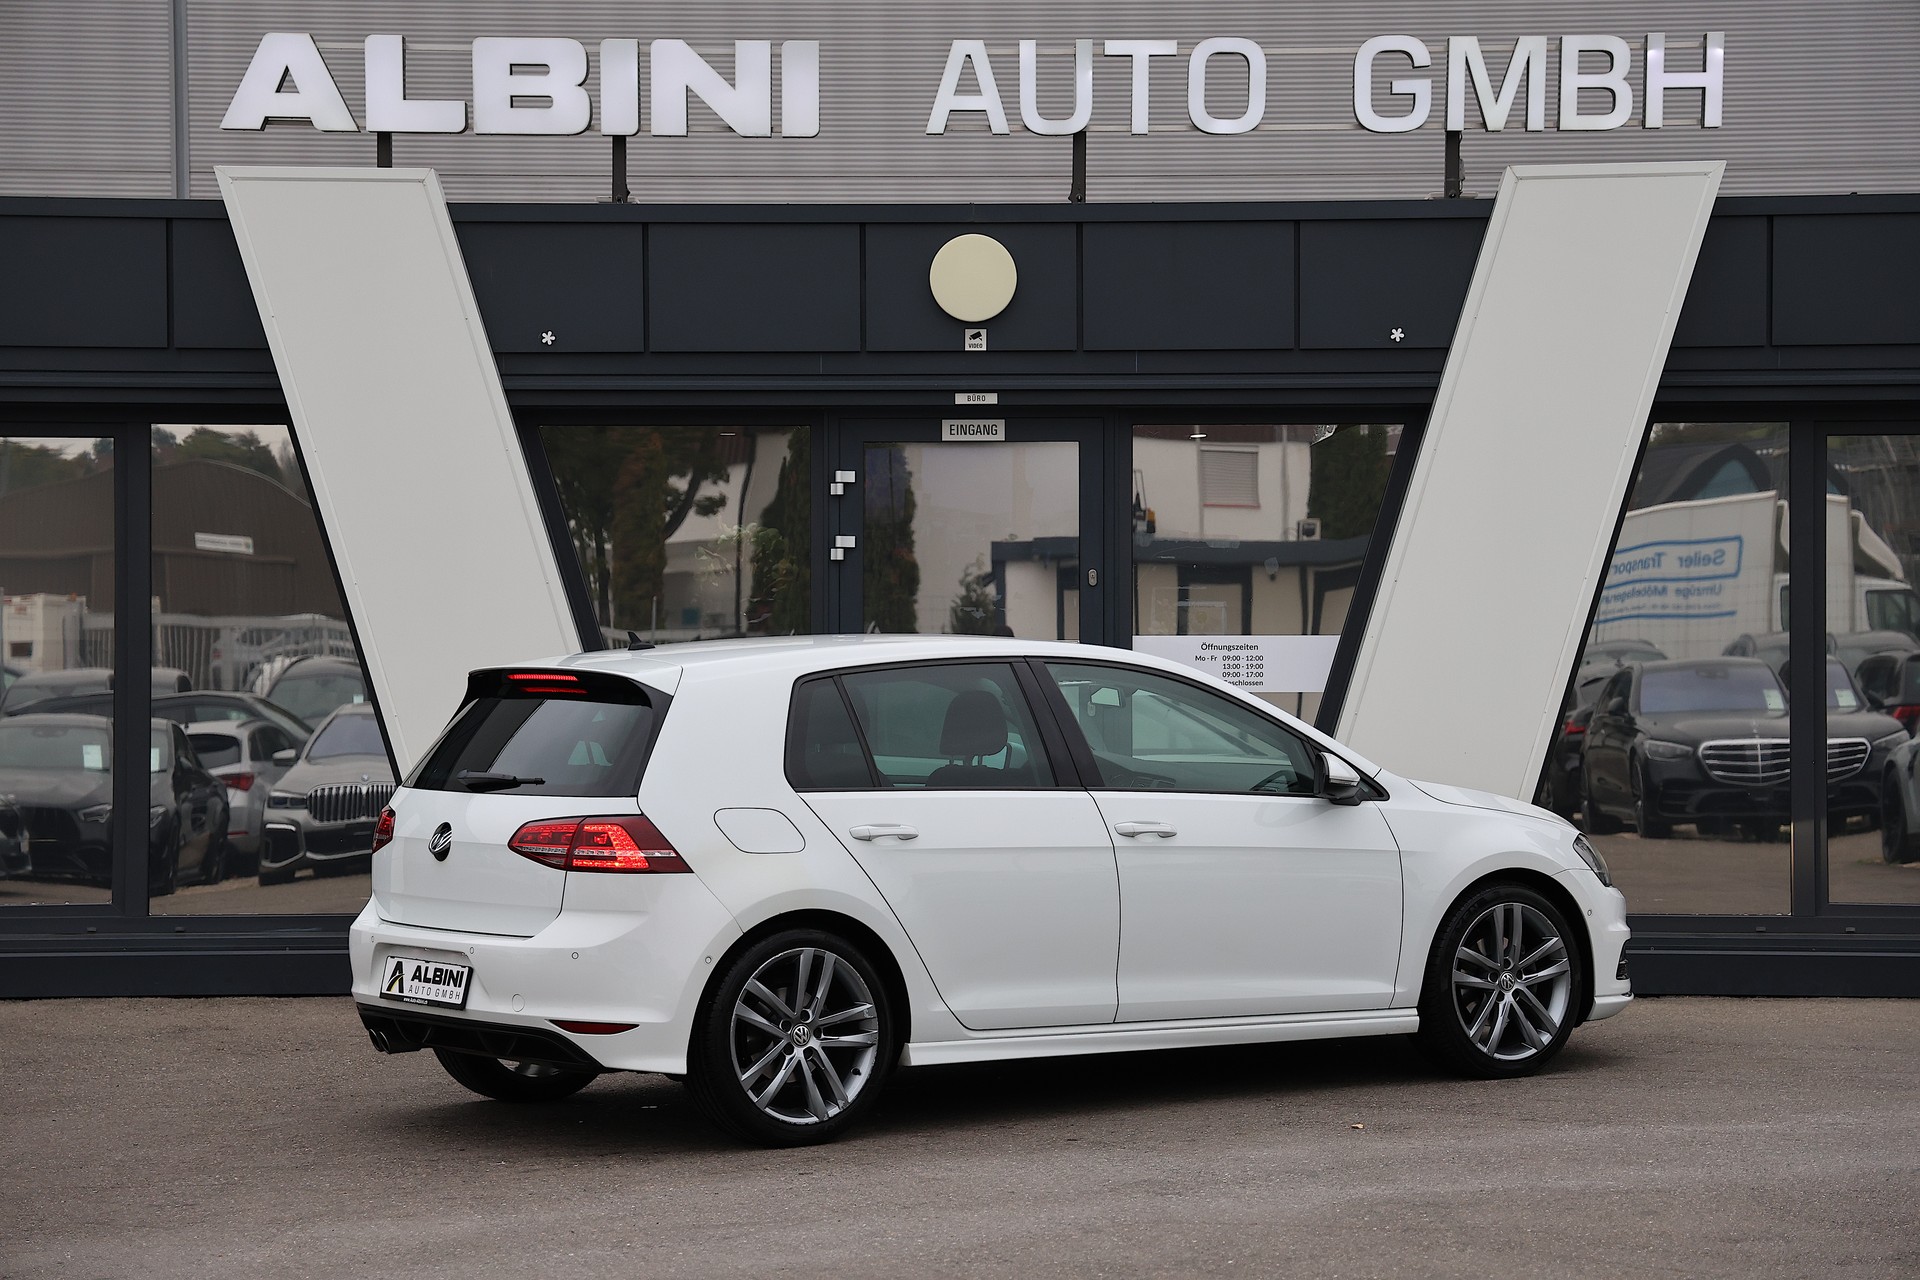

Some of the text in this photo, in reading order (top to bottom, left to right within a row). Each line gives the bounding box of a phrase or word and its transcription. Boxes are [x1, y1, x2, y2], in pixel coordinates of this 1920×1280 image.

[219, 31, 1725, 138] ALBINI AUTO GMBH
[967, 393, 986, 402] BÜRO
[949, 424, 998, 436] EINGANG
[1200, 642, 1259, 652] Öffnungszeiten
[1223, 679, 1264, 687] schlossen
[411, 964, 464, 988] ALBINI
[408, 985, 461, 1000] AUTO GMBH
